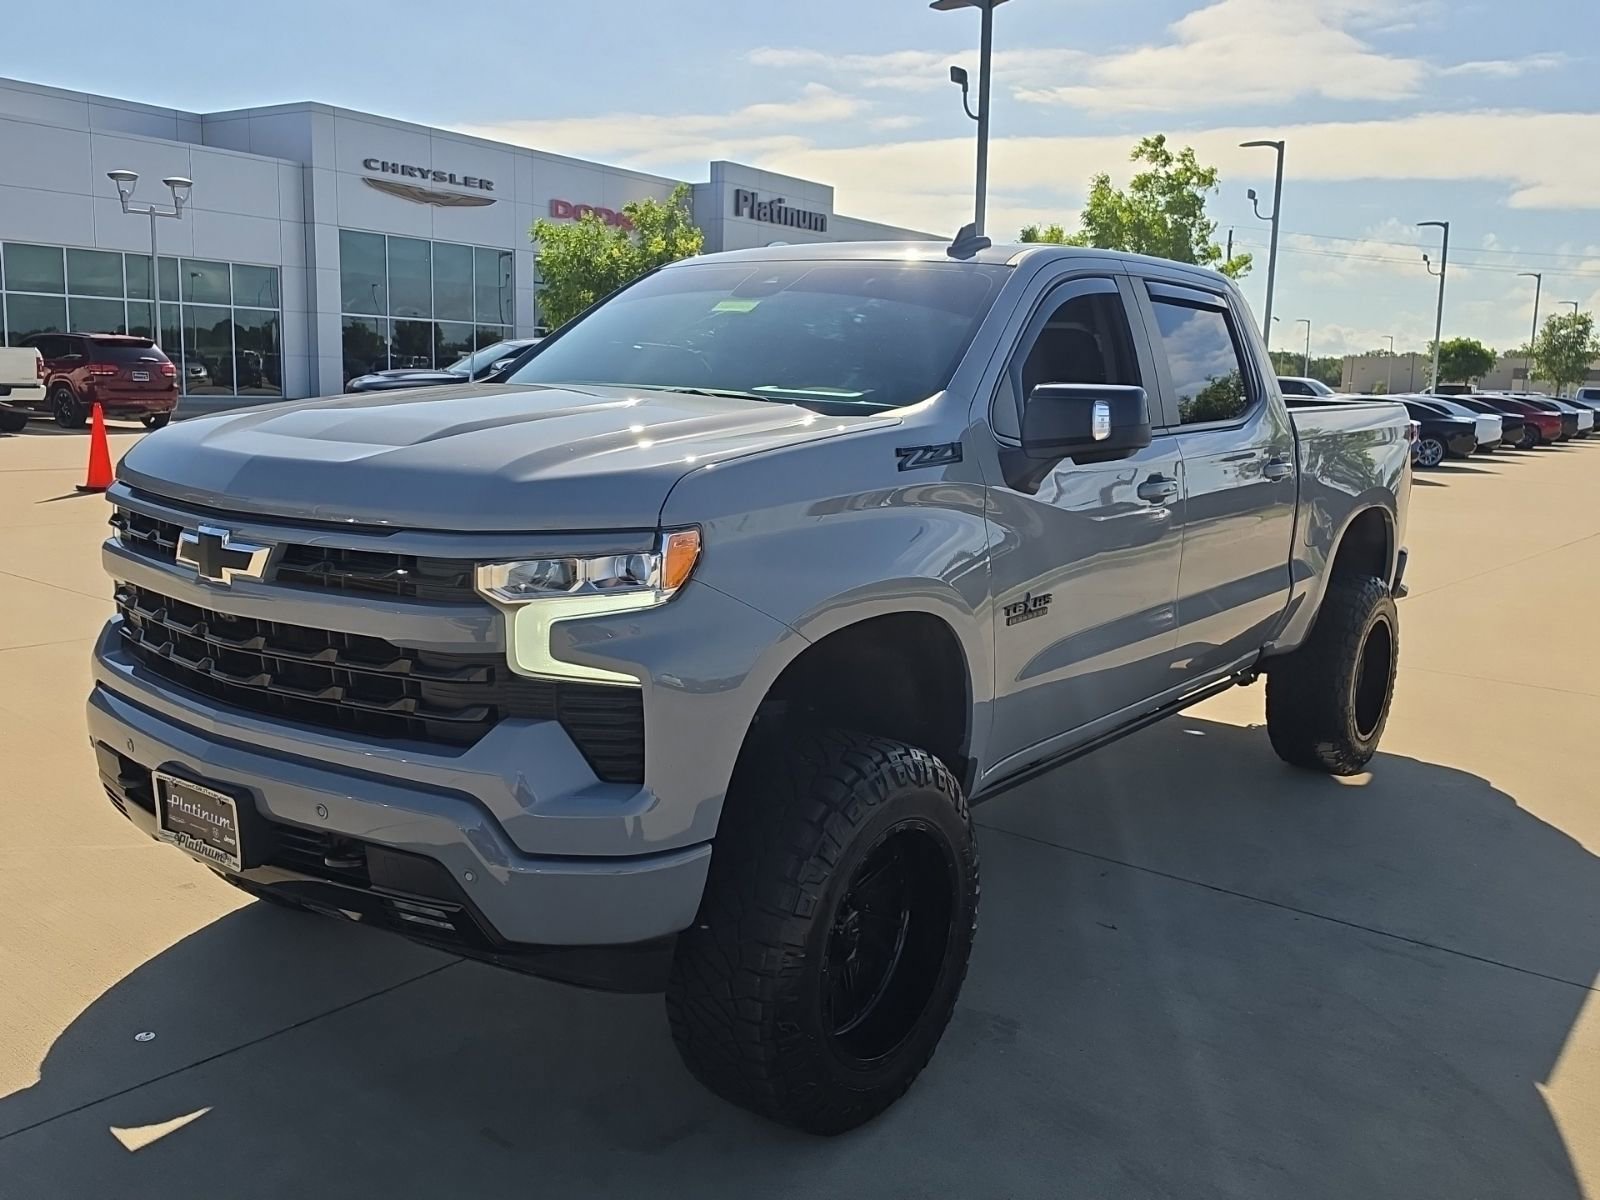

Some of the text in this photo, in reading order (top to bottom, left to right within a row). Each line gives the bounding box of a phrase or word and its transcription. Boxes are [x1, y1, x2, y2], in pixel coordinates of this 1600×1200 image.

[363, 158, 494, 191] CHRYSLER
[735, 188, 827, 232] Platinum
[1002, 592, 1052, 616] TEXAS
[167, 794, 234, 830] Platinum
[174, 832, 228, 864] Platinum
